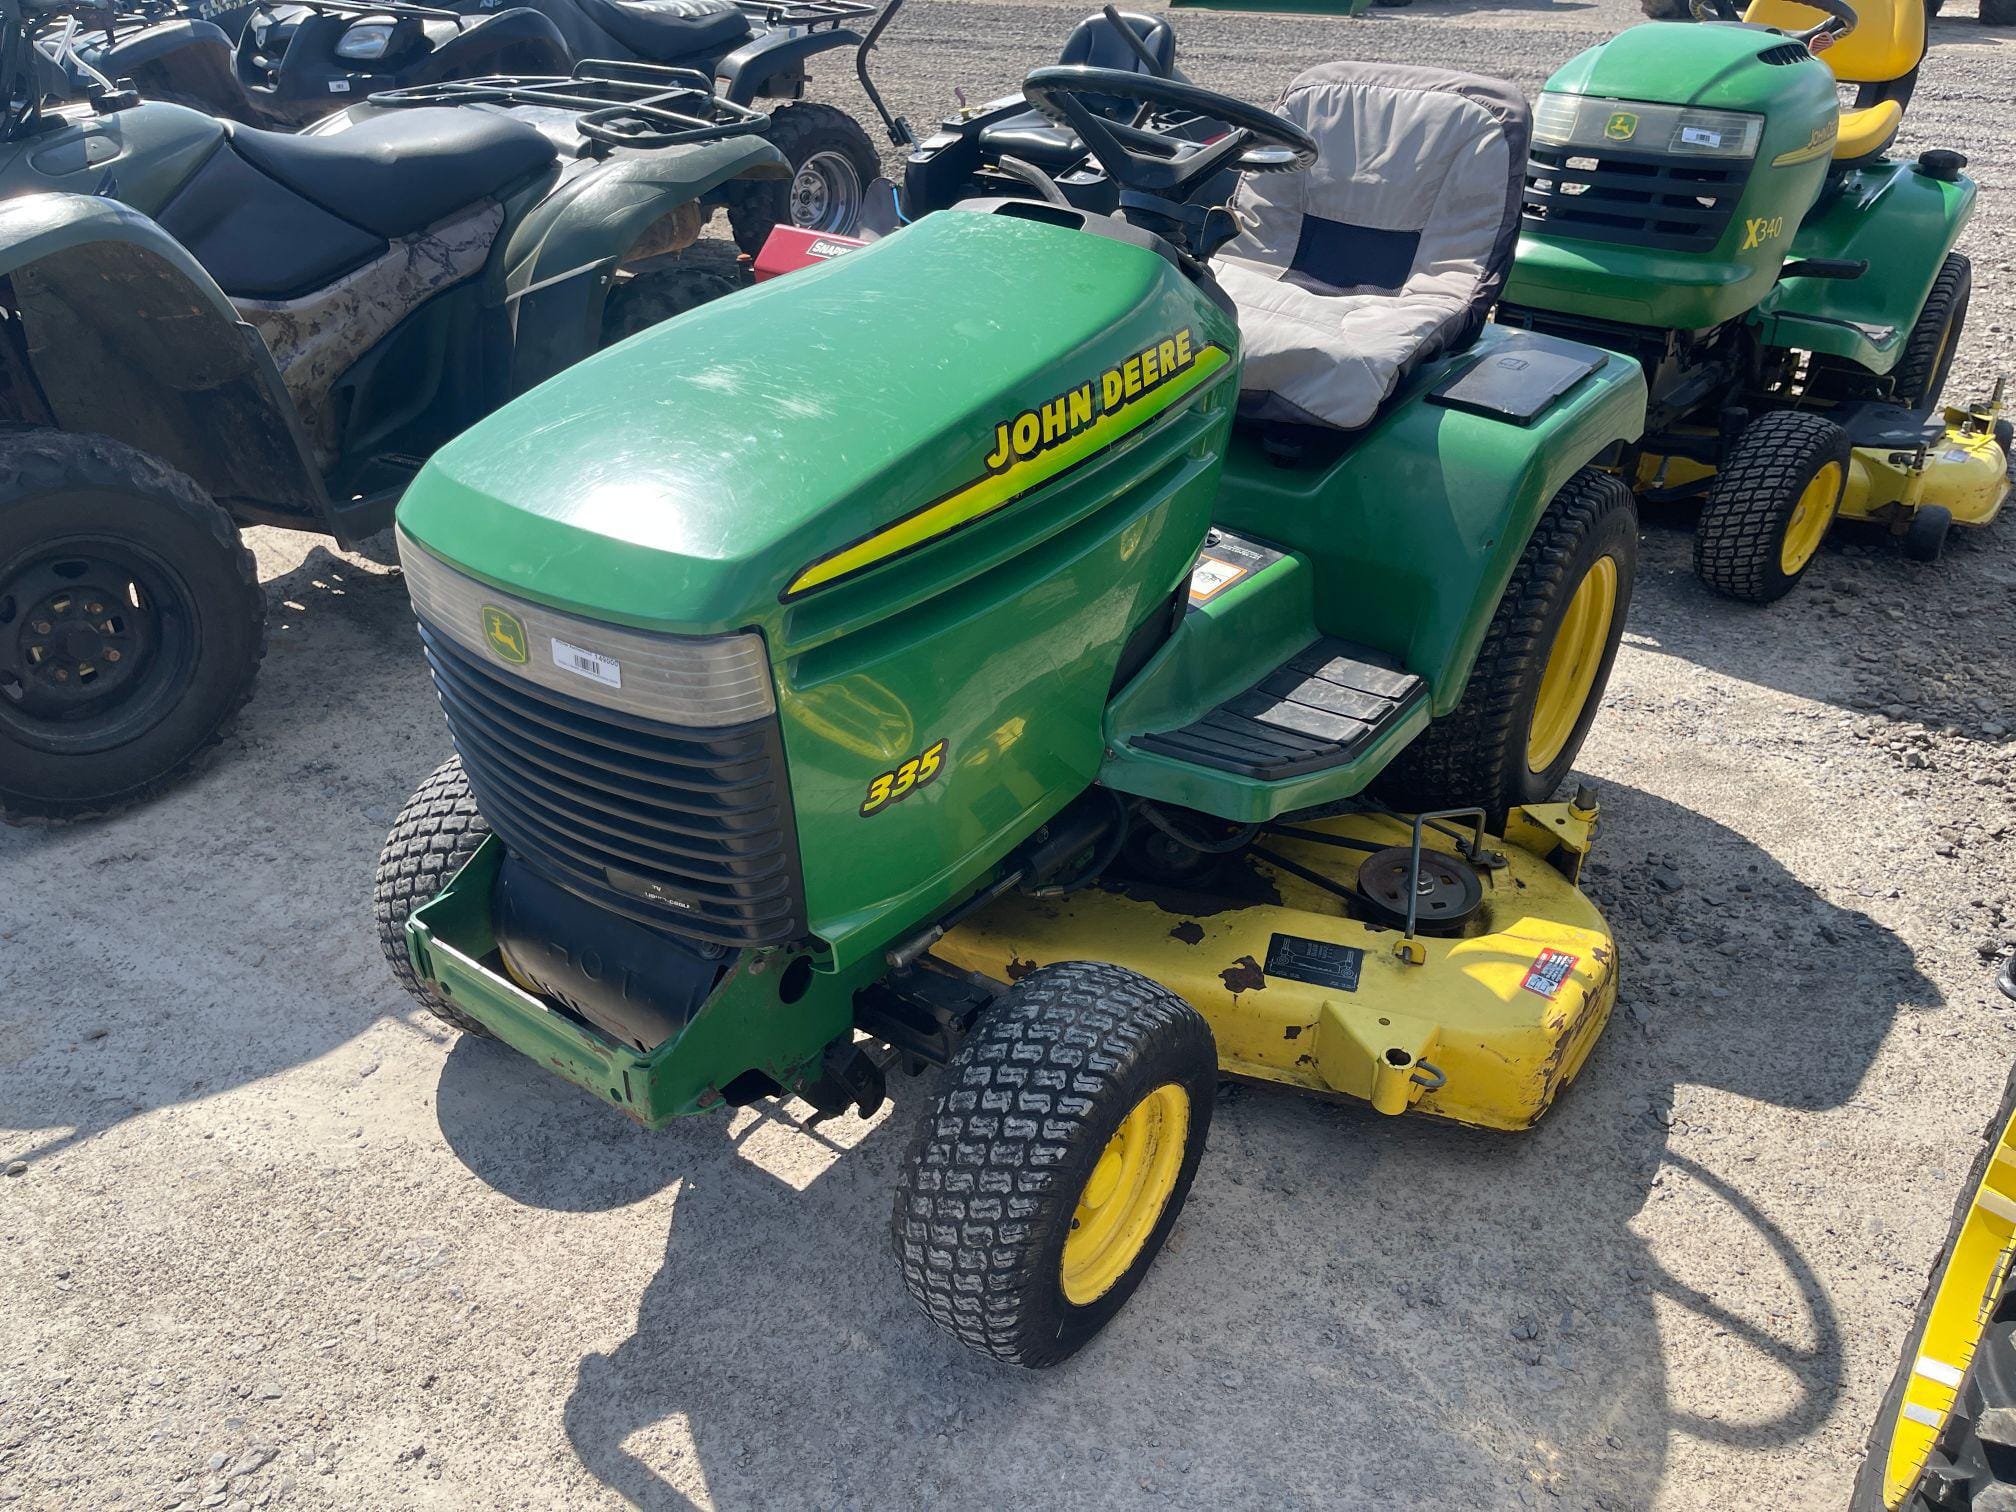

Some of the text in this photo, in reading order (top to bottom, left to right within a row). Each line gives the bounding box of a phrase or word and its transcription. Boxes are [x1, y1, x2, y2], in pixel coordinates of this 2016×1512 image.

[812, 241, 852, 256] SNAPP
[1742, 216, 1783, 250] X340
[987, 328, 1191, 468] JOHN DEERE
[863, 742, 944, 812] 335
